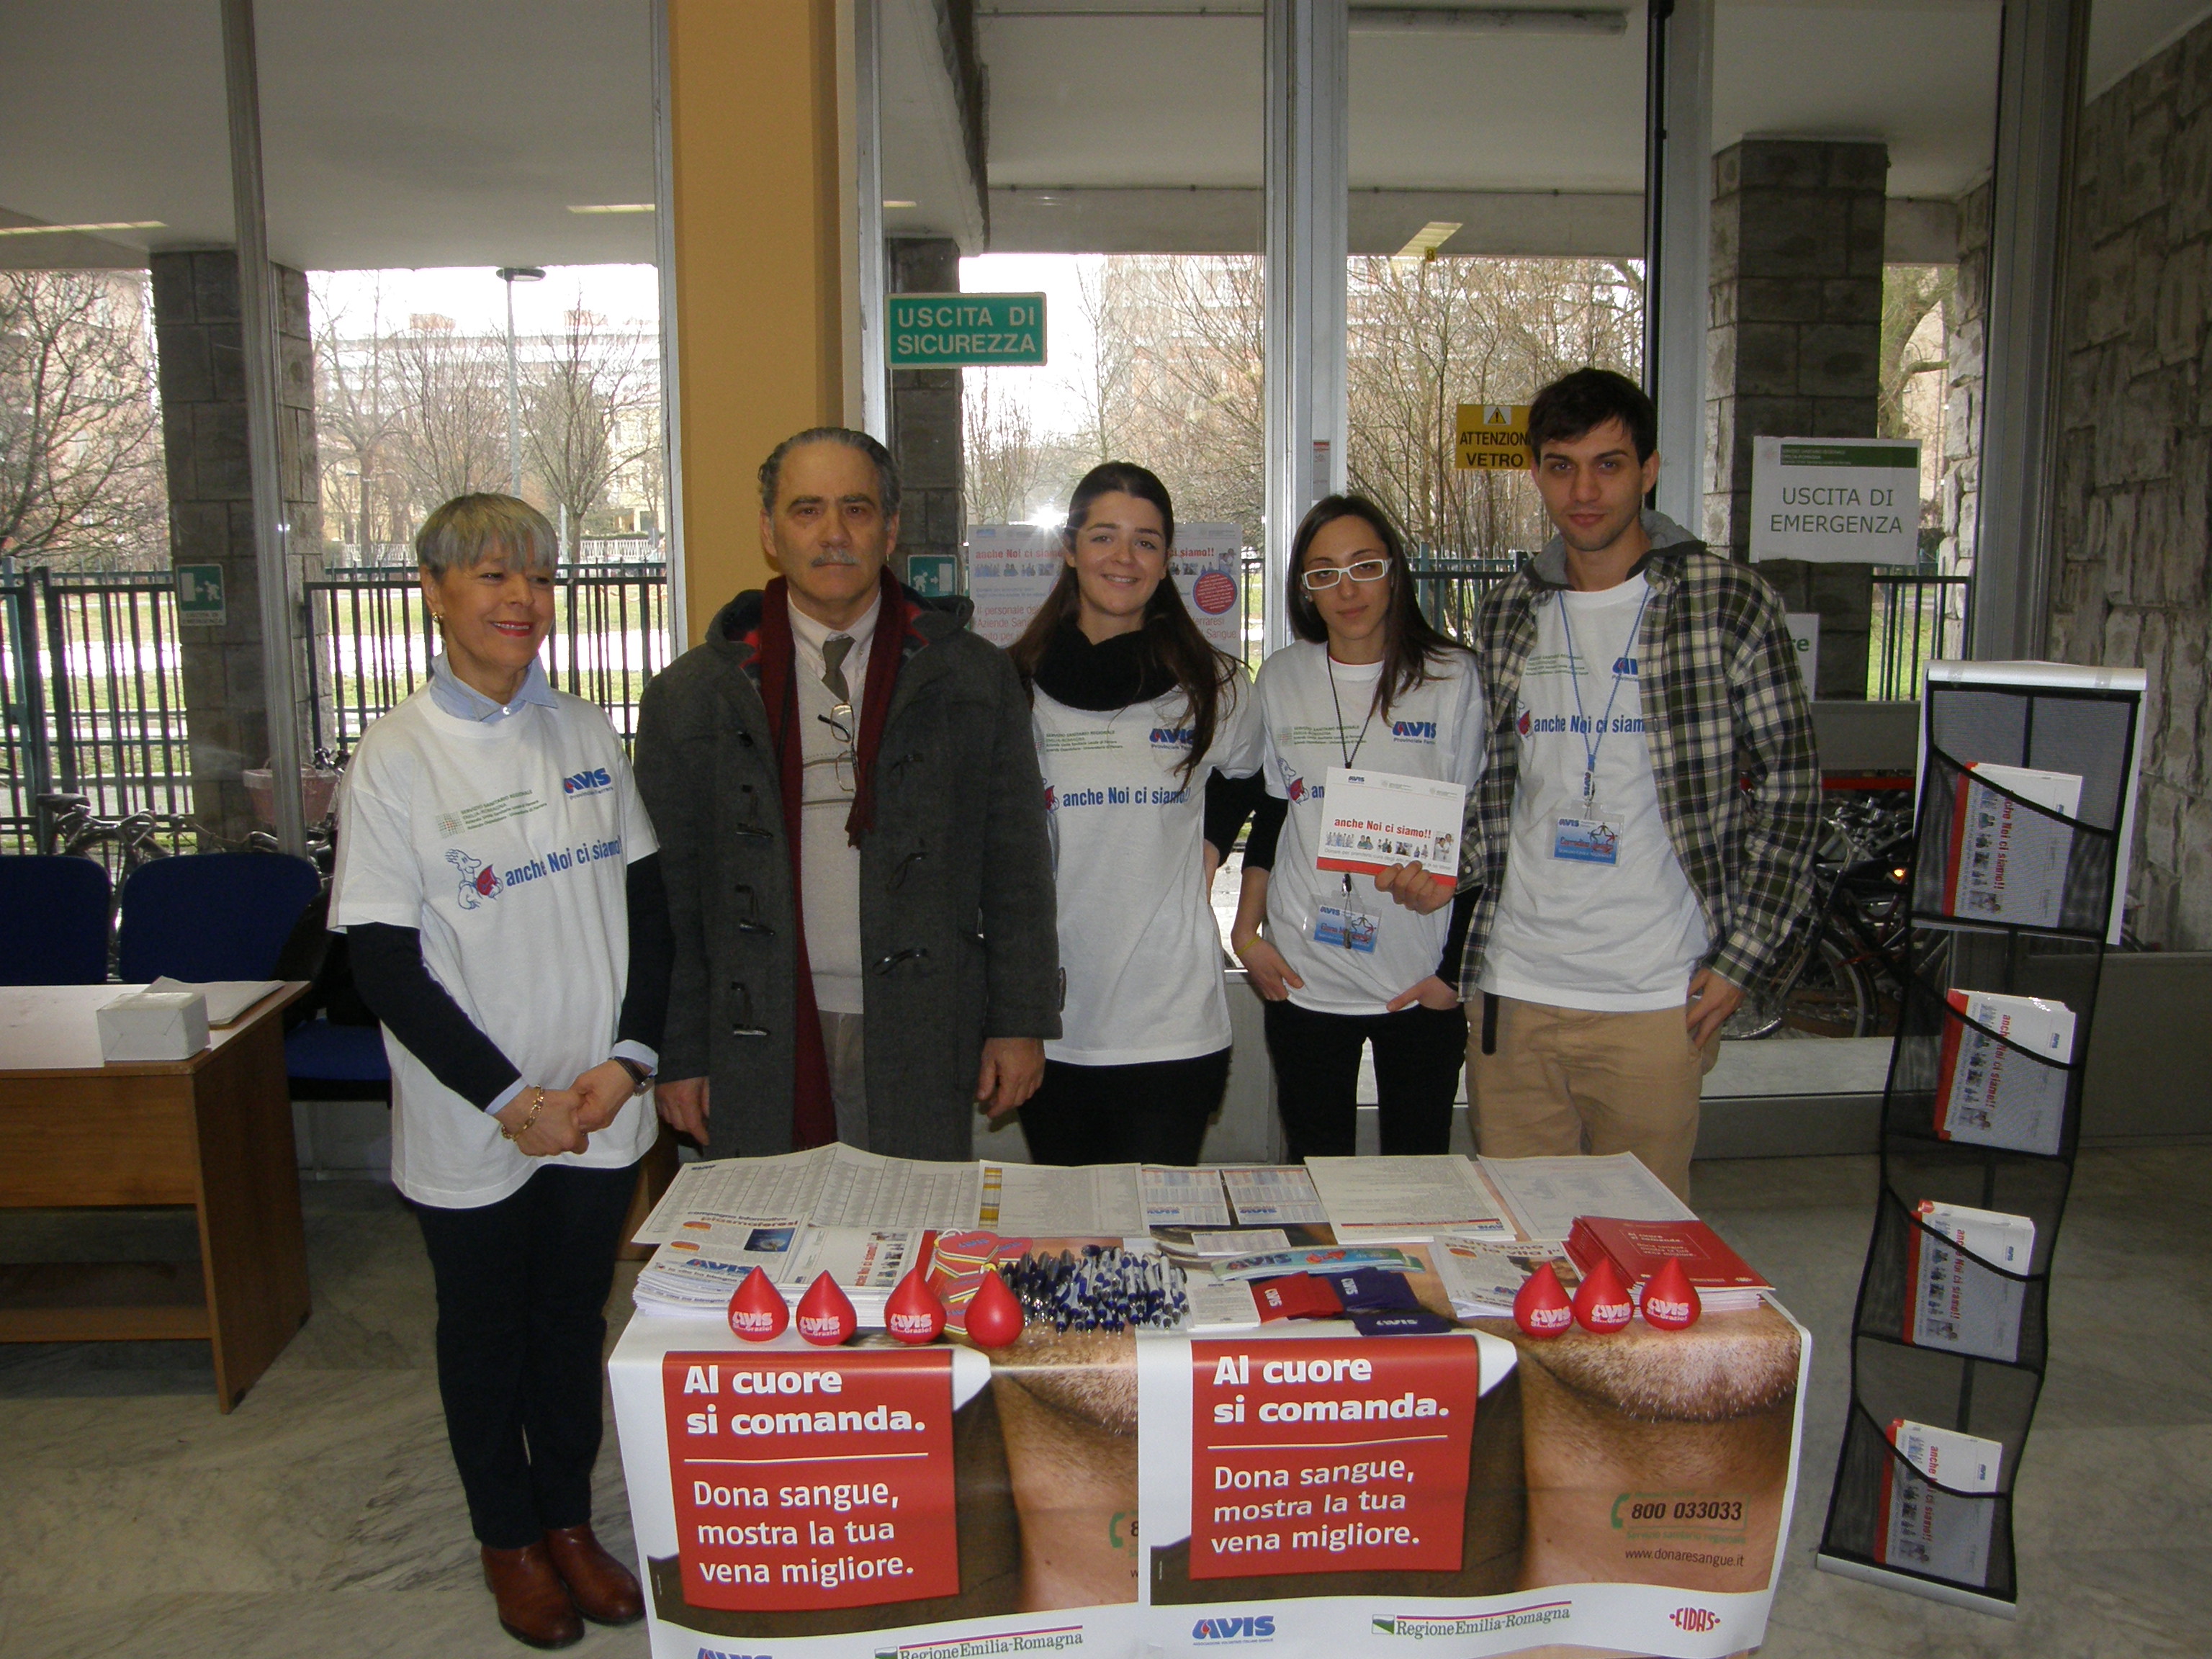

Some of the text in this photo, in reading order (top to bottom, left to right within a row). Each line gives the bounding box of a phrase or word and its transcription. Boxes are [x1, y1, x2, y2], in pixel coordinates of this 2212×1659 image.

[898, 307, 1035, 328] USCITA DI
[897, 333, 1036, 354] SICUREZZA
[1460, 431, 1531, 446] ATTENZION
[1466, 453, 1524, 467] VETRO
[1782, 487, 1894, 506] USCITA DI
[1770, 514, 1902, 534] EMERGENZA
[1007, 549, 1021, 559] Noi
[1180, 548, 1214, 557] siamo!!
[985, 605, 1024, 616] personale
[1207, 629, 1236, 639] Sangue
[1392, 721, 1437, 739] AVIS
[1534, 715, 1565, 732] anche
[1570, 715, 1591, 733] Noi
[1612, 715, 1646, 733] siam
[564, 768, 611, 793] AVIS
[1063, 788, 1104, 807] anche
[1108, 787, 1129, 804] Noi
[1135, 787, 1147, 804] ci
[1311, 785, 1325, 799] an
[1334, 818, 1431, 839] anche Noi ci siamo!!
[1559, 819, 1579, 827] AVIS
[2000, 823, 2013, 840] Noi
[1998, 841, 2010, 850] ci
[547, 848, 572, 873] Noi
[577, 842, 590, 864] ci
[1993, 853, 2008, 890] siamo!!
[1320, 906, 1340, 916] AVIS
[1999, 1014, 2011, 1038] anch
[686, 1259, 755, 1274] AVIS
[1341, 1277, 1359, 1295] AVIS
[1264, 1287, 1282, 1308] AVIS
[1647, 1297, 1689, 1316] AVIS
[732, 1311, 773, 1327] AVIS
[1530, 1306, 1571, 1323] AVIS
[1591, 1302, 1630, 1318] AVIS
[799, 1316, 840, 1331] AVIS
[890, 1313, 932, 1328] AVIS
[684, 1365, 842, 1394] Al cuore
[1213, 1356, 1372, 1385] Al cuore
[1214, 1393, 1449, 1424] si comanda.
[687, 1404, 925, 1435] si comanda.
[1928, 1445, 1939, 1475] anche
[1215, 1460, 1414, 1490] Dona sangue,
[694, 1480, 899, 1511] Dona sangue,
[1214, 1490, 1406, 1522] mostra la tua
[1631, 1501, 1743, 1521] 800 033033
[698, 1520, 894, 1545] mostra la tua
[1130, 1520, 1138, 1537] 8
[1211, 1524, 1419, 1553] vena migliore.
[1625, 1548, 1745, 1568] www.donaresangue.it
[699, 1556, 914, 1588] vena migliore.
[1192, 1615, 1275, 1640] AVIS
[1675, 1607, 1715, 1632] FIDAS
